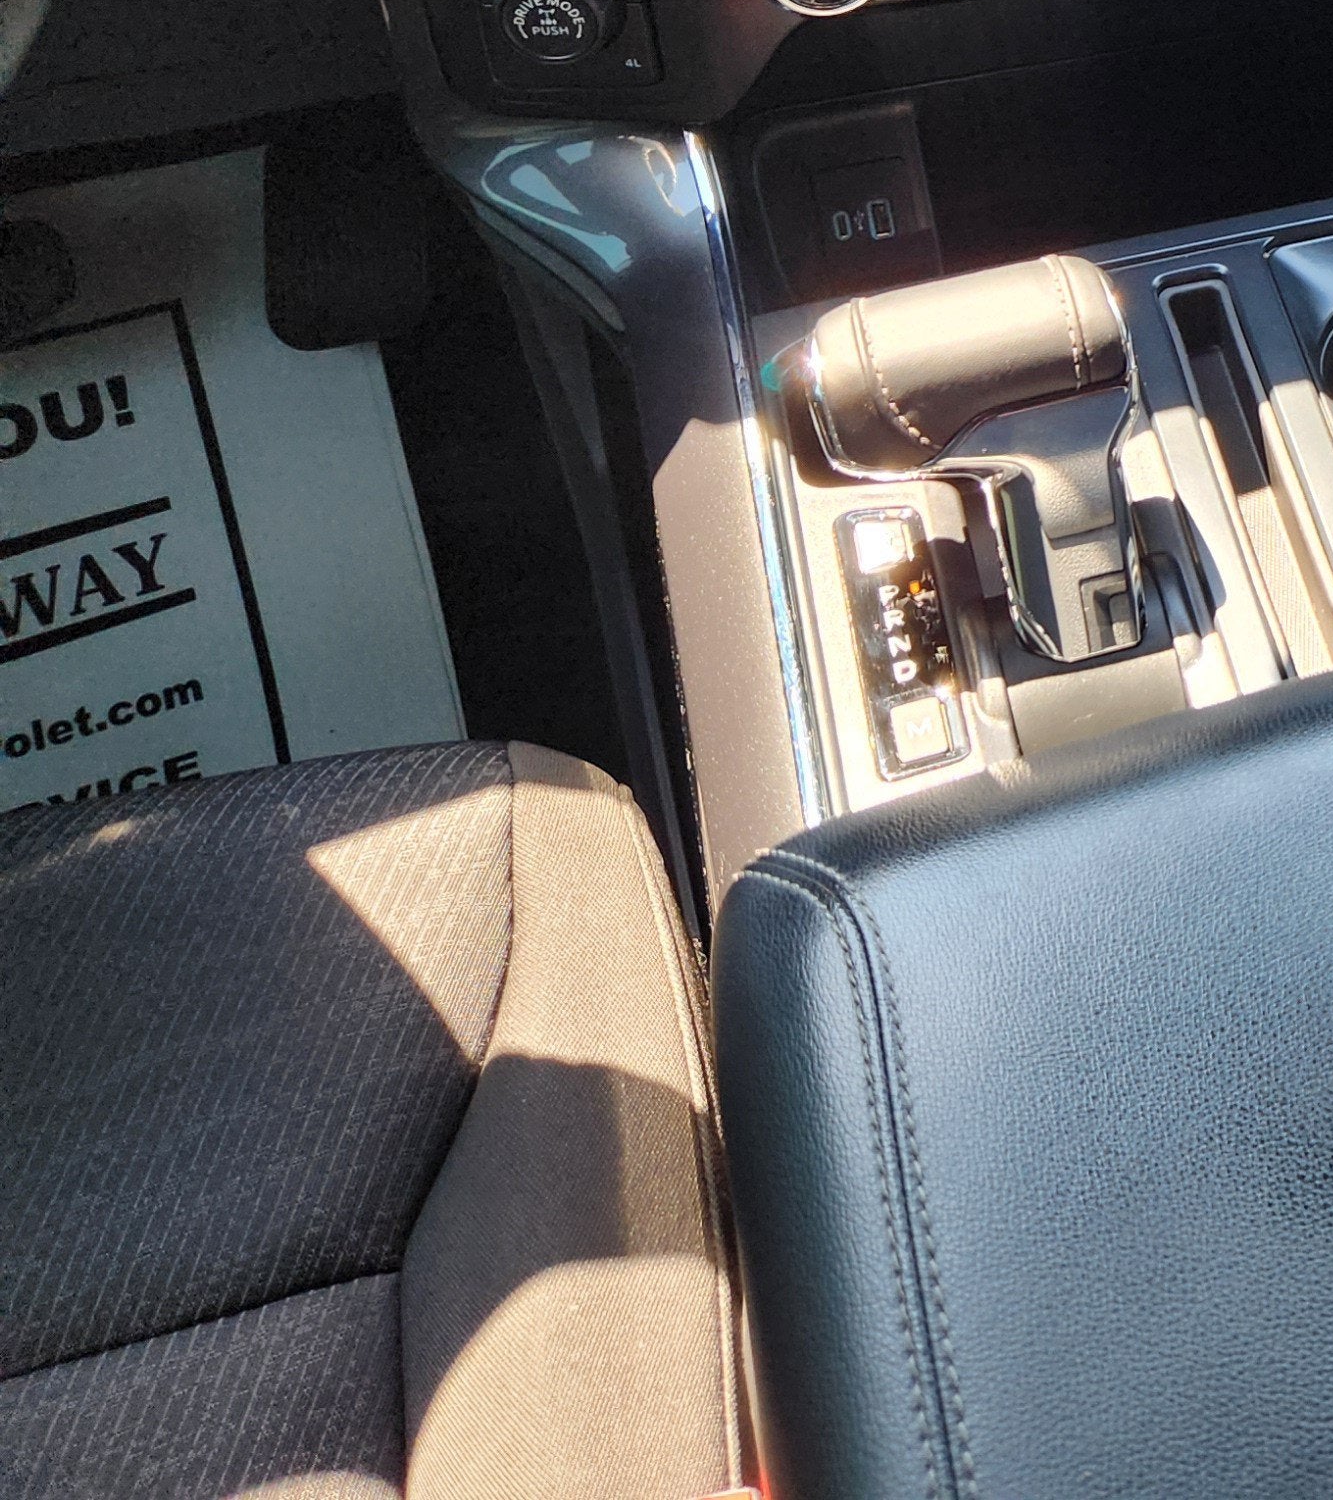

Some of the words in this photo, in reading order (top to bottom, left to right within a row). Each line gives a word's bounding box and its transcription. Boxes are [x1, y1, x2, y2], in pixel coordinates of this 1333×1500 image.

[532, 26, 570, 36] PUSH
[625, 58, 642, 69] 4L
[882, 609, 905, 633] R
[888, 633, 912, 658] N
[892, 659, 918, 684] D
[907, 719, 932, 738] M
